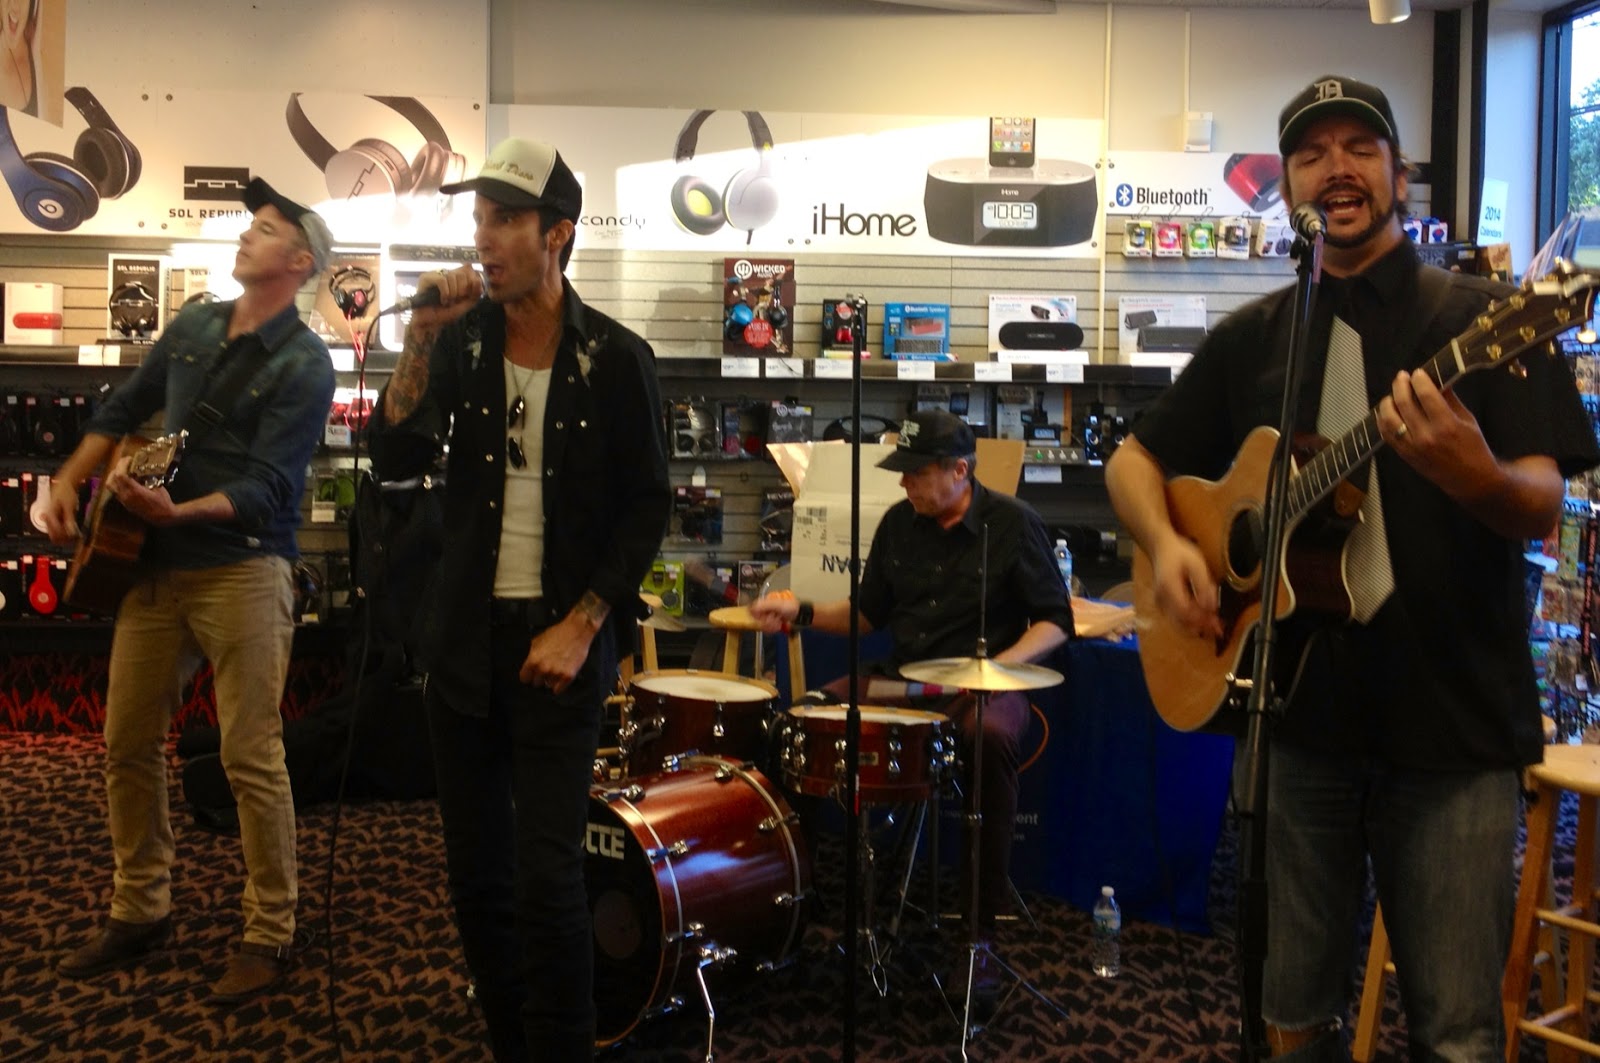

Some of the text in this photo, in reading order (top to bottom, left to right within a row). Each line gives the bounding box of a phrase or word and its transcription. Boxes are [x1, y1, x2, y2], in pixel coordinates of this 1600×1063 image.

[1136, 187, 1208, 206] Bluetooth
[169, 208, 193, 218] SOL
[993, 203, 1033, 219] 10:09
[1484, 206, 1501, 221] 2014
[580, 213, 646, 230] candy
[813, 203, 917, 237] iHome
[752, 264, 786, 275] WICKED
